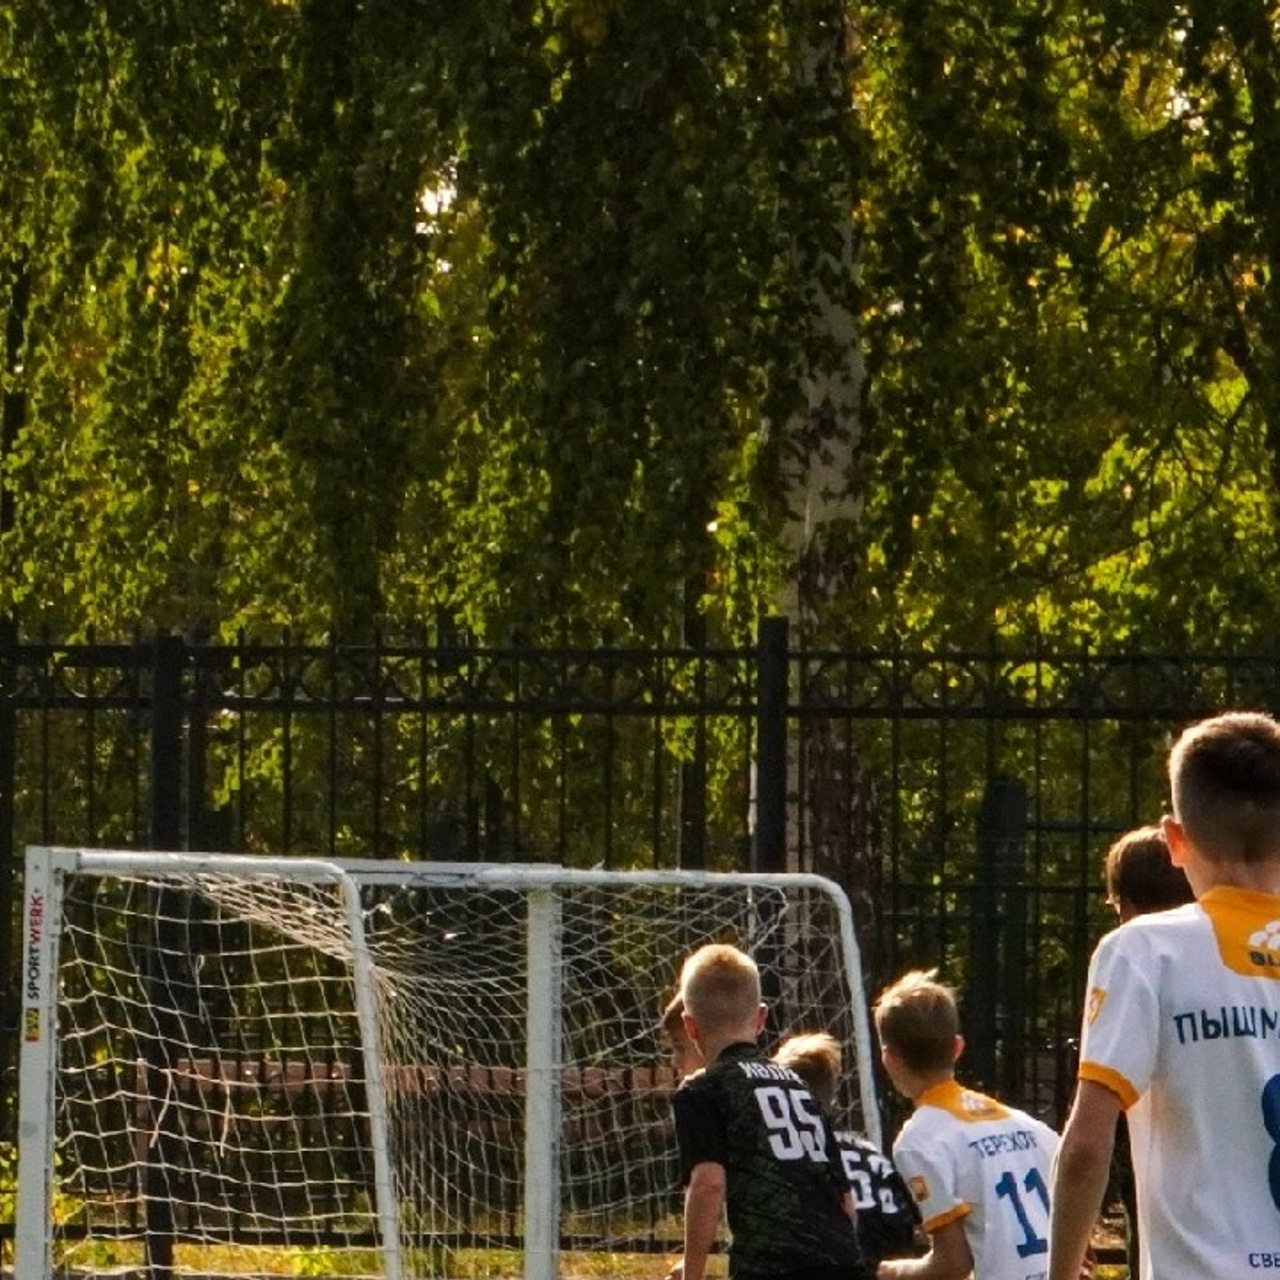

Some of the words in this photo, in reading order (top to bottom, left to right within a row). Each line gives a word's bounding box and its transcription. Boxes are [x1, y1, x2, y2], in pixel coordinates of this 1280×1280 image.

[27, 895, 44, 1000] SPORTWERK
[754, 1086, 829, 1162] 95
[995, 1167, 1050, 1258] 11
